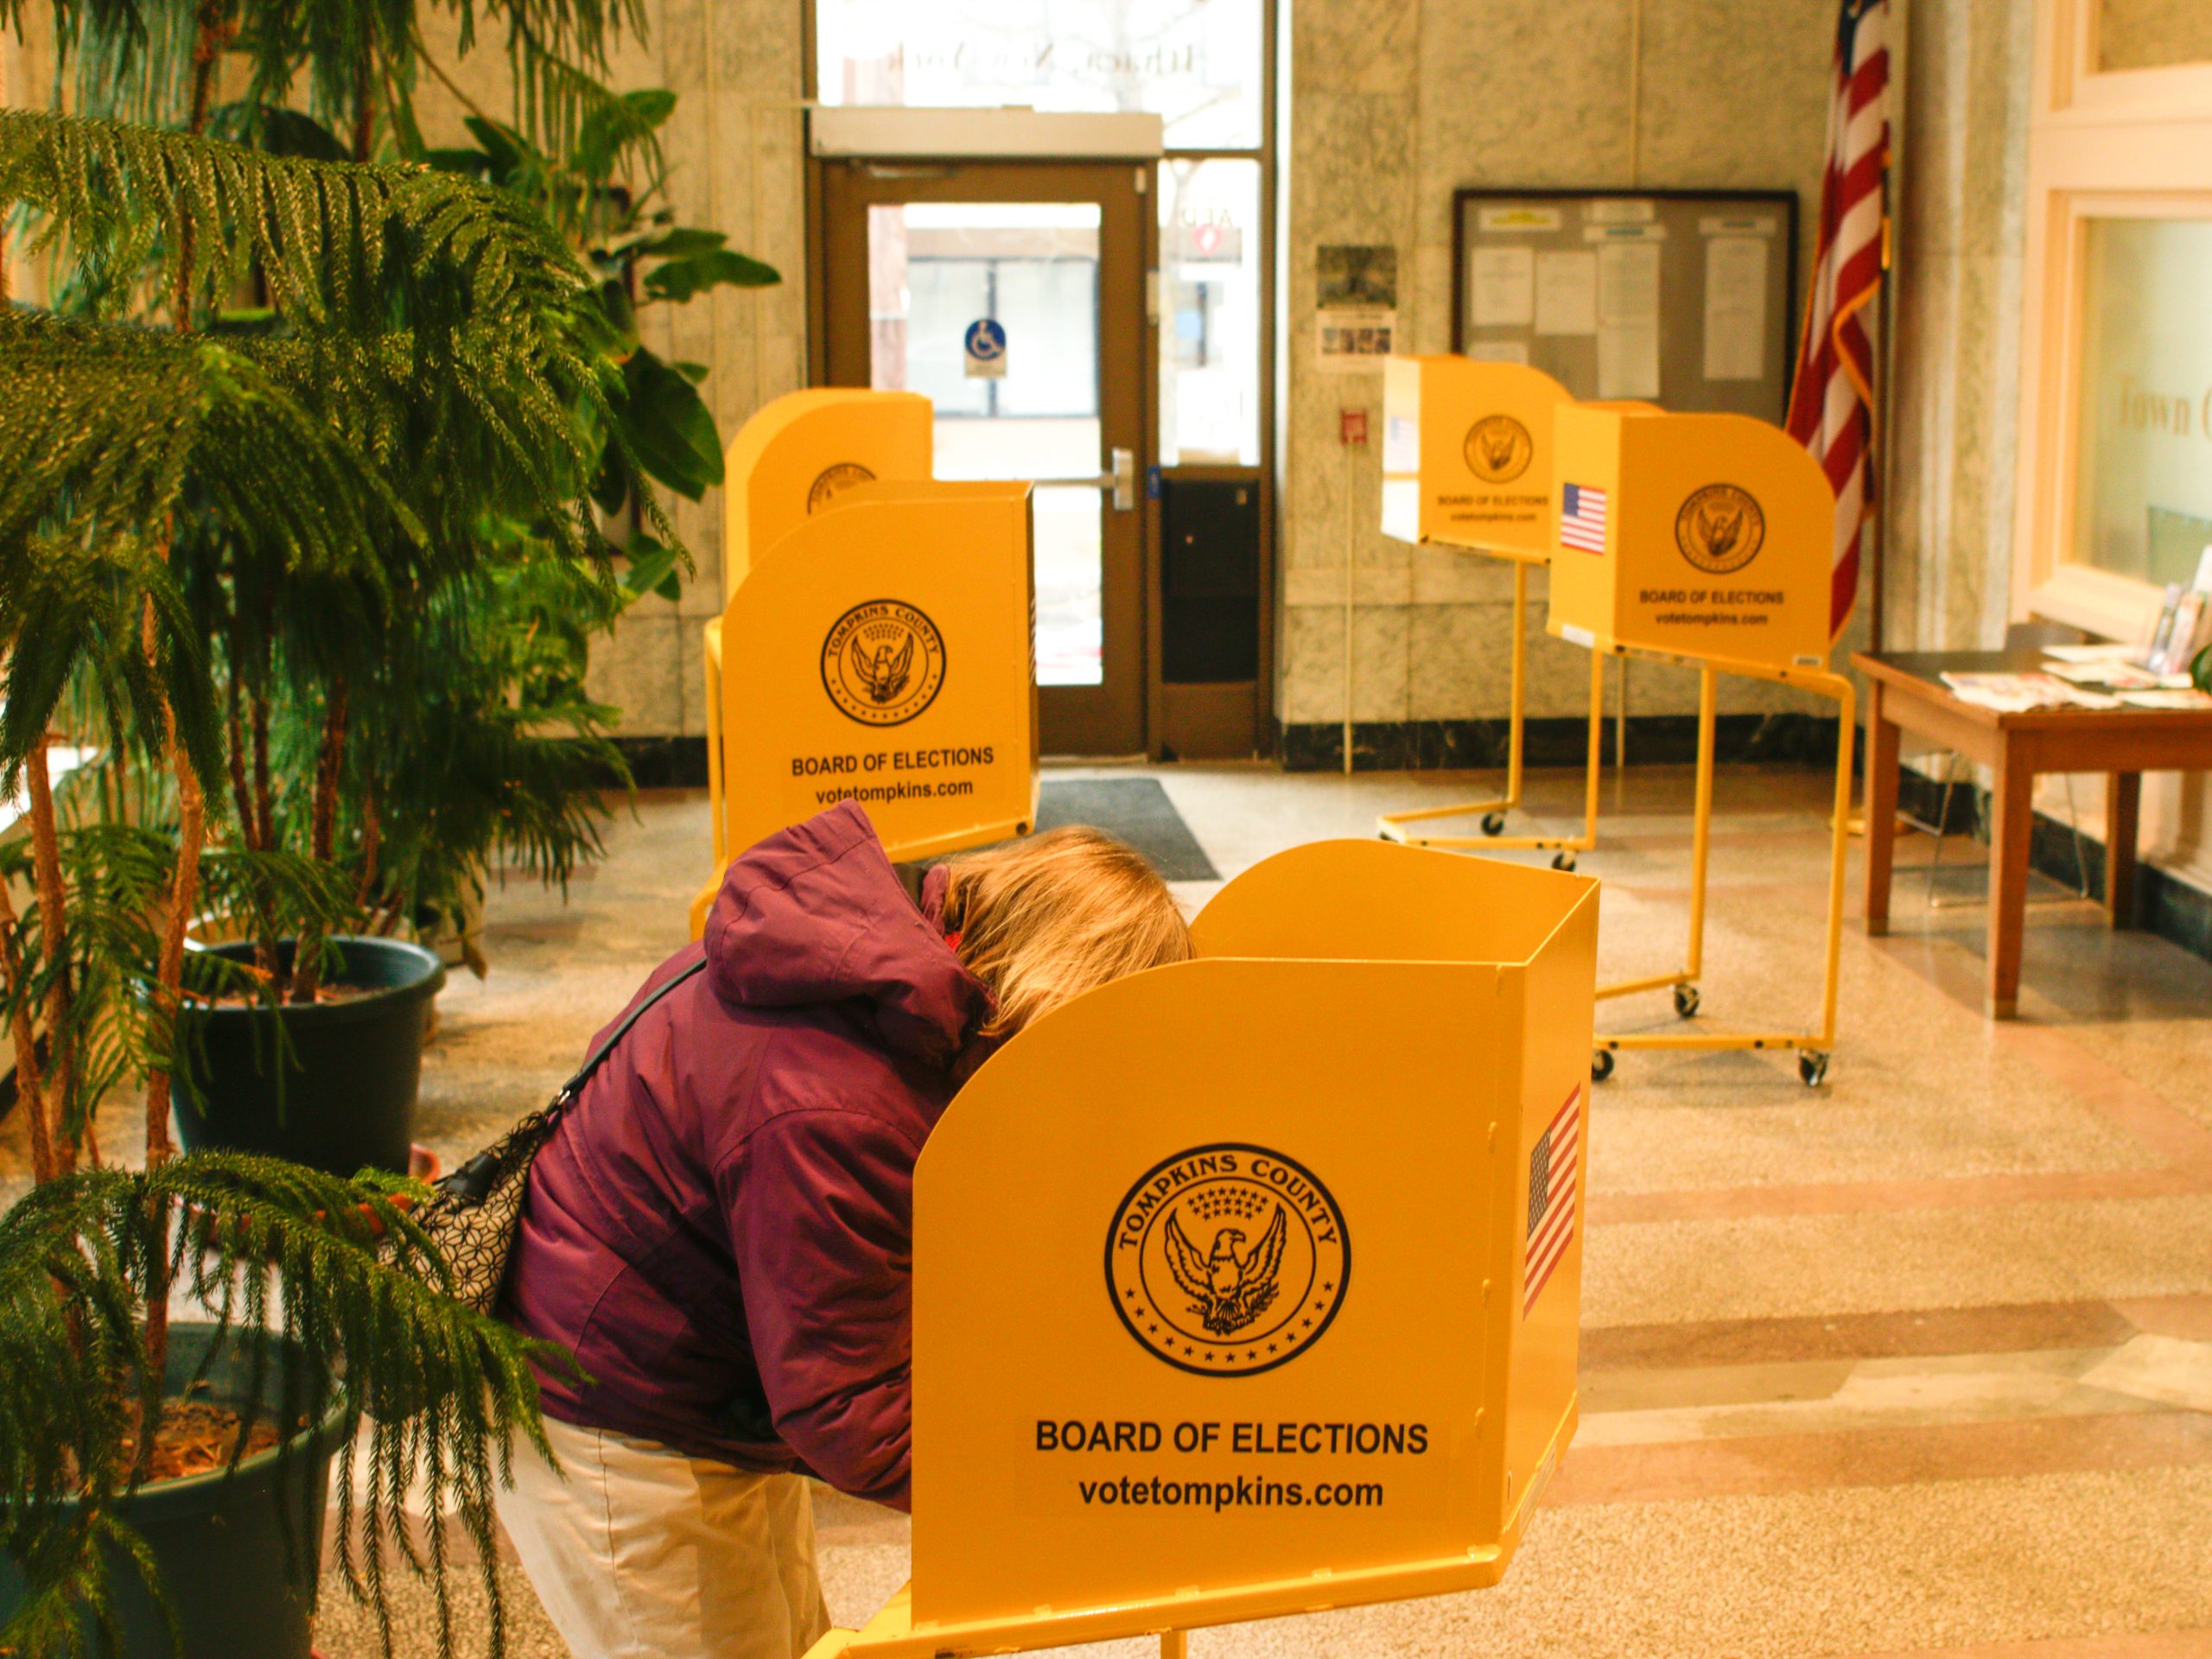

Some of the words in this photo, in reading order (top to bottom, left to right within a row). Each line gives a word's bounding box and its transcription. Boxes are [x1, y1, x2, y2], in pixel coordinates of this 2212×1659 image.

[2116, 373, 2190, 437] Town
[1639, 589, 1687, 604] BOARD
[1689, 589, 1707, 604] OF
[1711, 589, 1784, 604] ELECTIONS
[828, 605, 889, 659] TOMPKINS
[895, 607, 940, 655] COUNTY
[1656, 612, 1769, 626] votetompkins.com
[791, 755, 858, 776] BOARD
[863, 753, 887, 772] OF
[893, 747, 994, 770] ELECTIONS
[816, 780, 973, 804] votetompkins.com
[1119, 1154, 1237, 1251] TOMPKINS
[1251, 1159, 1338, 1247] COUNTY
[1036, 1421, 1162, 1452] BOARD
[1173, 1422, 1220, 1452] OF
[1232, 1423, 1428, 1455] ELECTIONS
[1079, 1476, 1383, 1513] votetompkins.com
